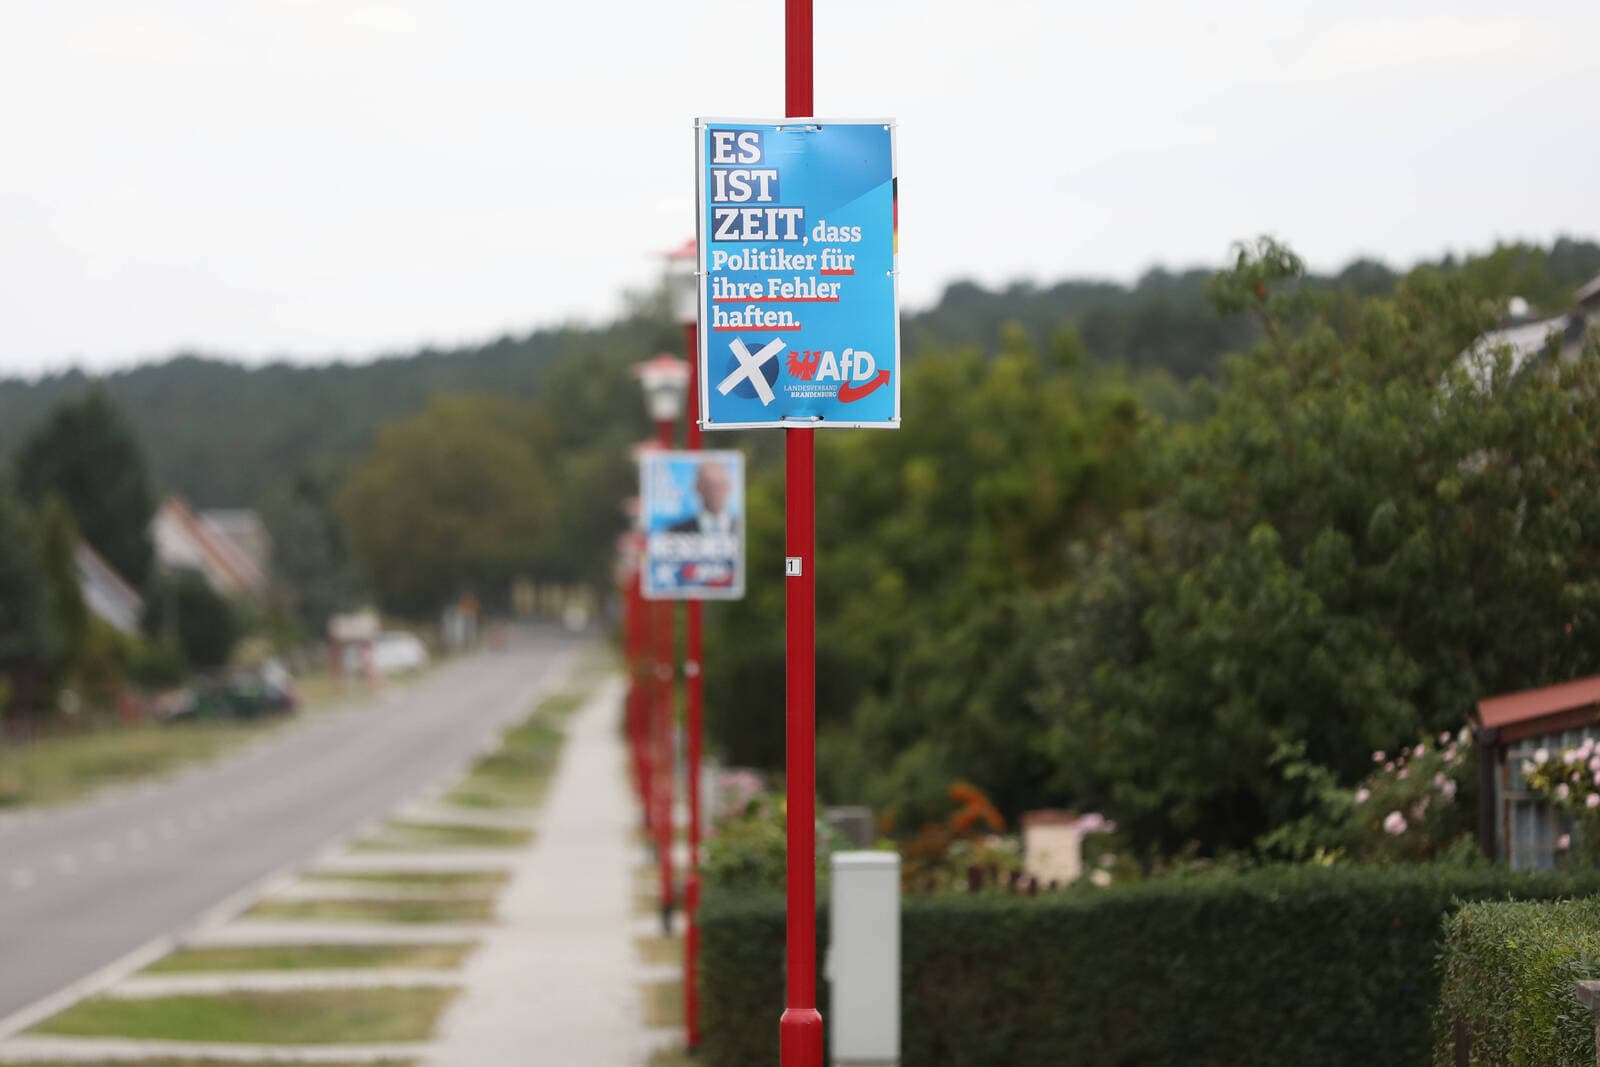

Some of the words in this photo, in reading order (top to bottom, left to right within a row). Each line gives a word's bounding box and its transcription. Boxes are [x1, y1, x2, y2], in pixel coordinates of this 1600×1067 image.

[712, 131, 761, 164] ES
[713, 169, 777, 202] IST
[812, 220, 862, 243] dass
[711, 248, 817, 271] Politiker
[820, 249, 855, 271] für
[712, 276, 763, 298] ihre
[767, 276, 841, 299] Fehler
[712, 305, 801, 327] haften.
[816, 347, 876, 382] AfD
